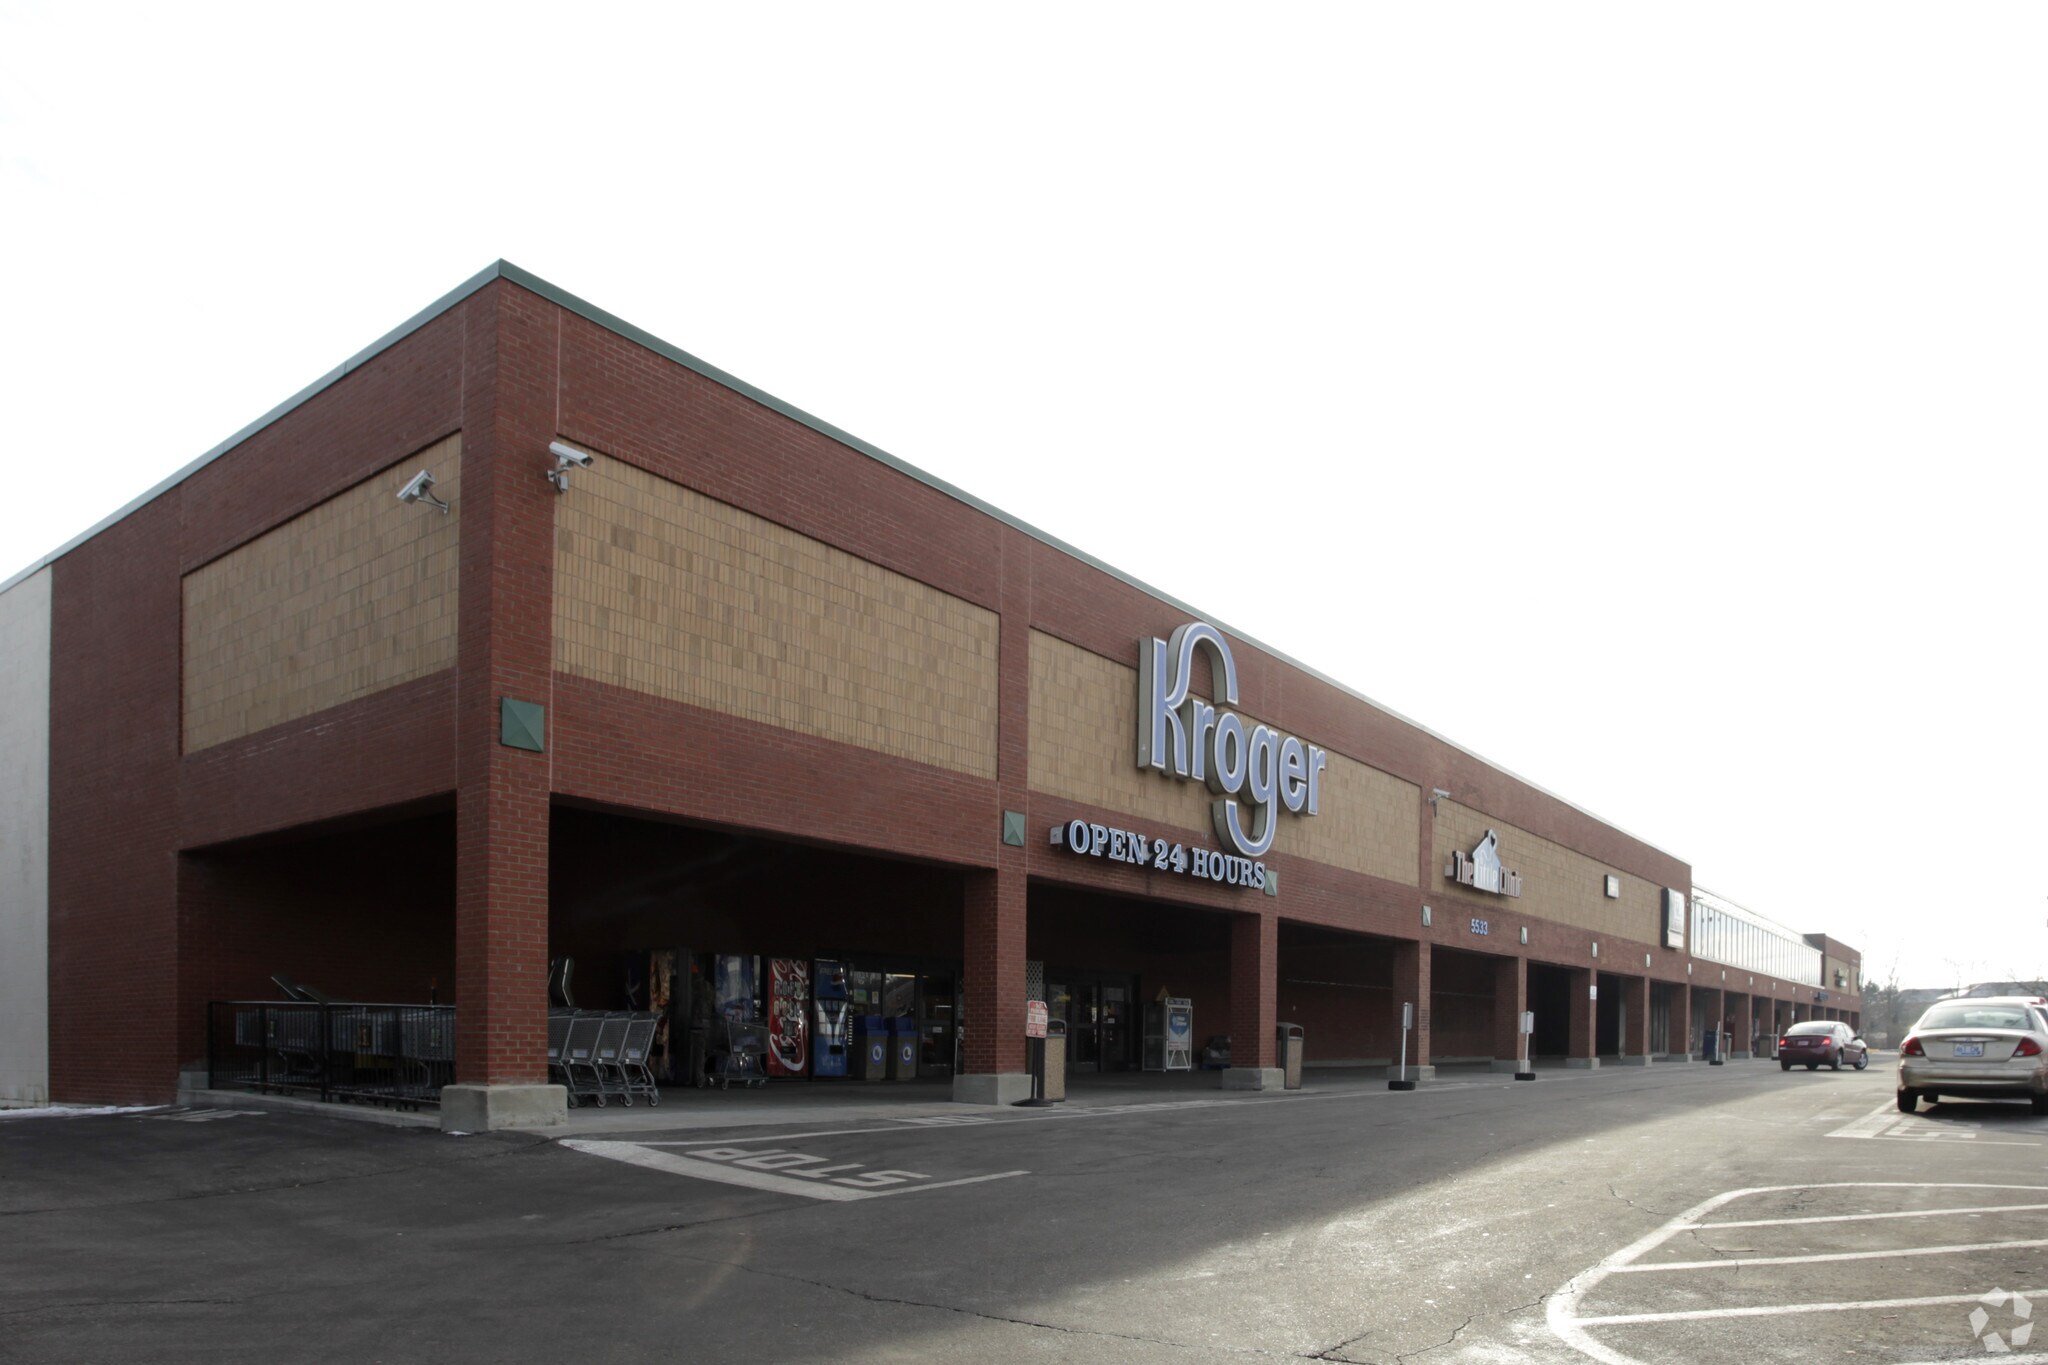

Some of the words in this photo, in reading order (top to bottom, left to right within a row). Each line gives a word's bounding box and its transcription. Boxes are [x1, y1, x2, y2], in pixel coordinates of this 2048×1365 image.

[1148, 622, 1326, 857] Kroger
[1068, 819, 1146, 865] OPEN
[1154, 838, 1184, 873] 24
[1191, 847, 1266, 890] HOURS
[1455, 850, 1474, 886] The
[1499, 865, 1523, 898] Clinic
[1470, 917, 1488, 936] 5533
[685, 1147, 933, 1188] STOP
